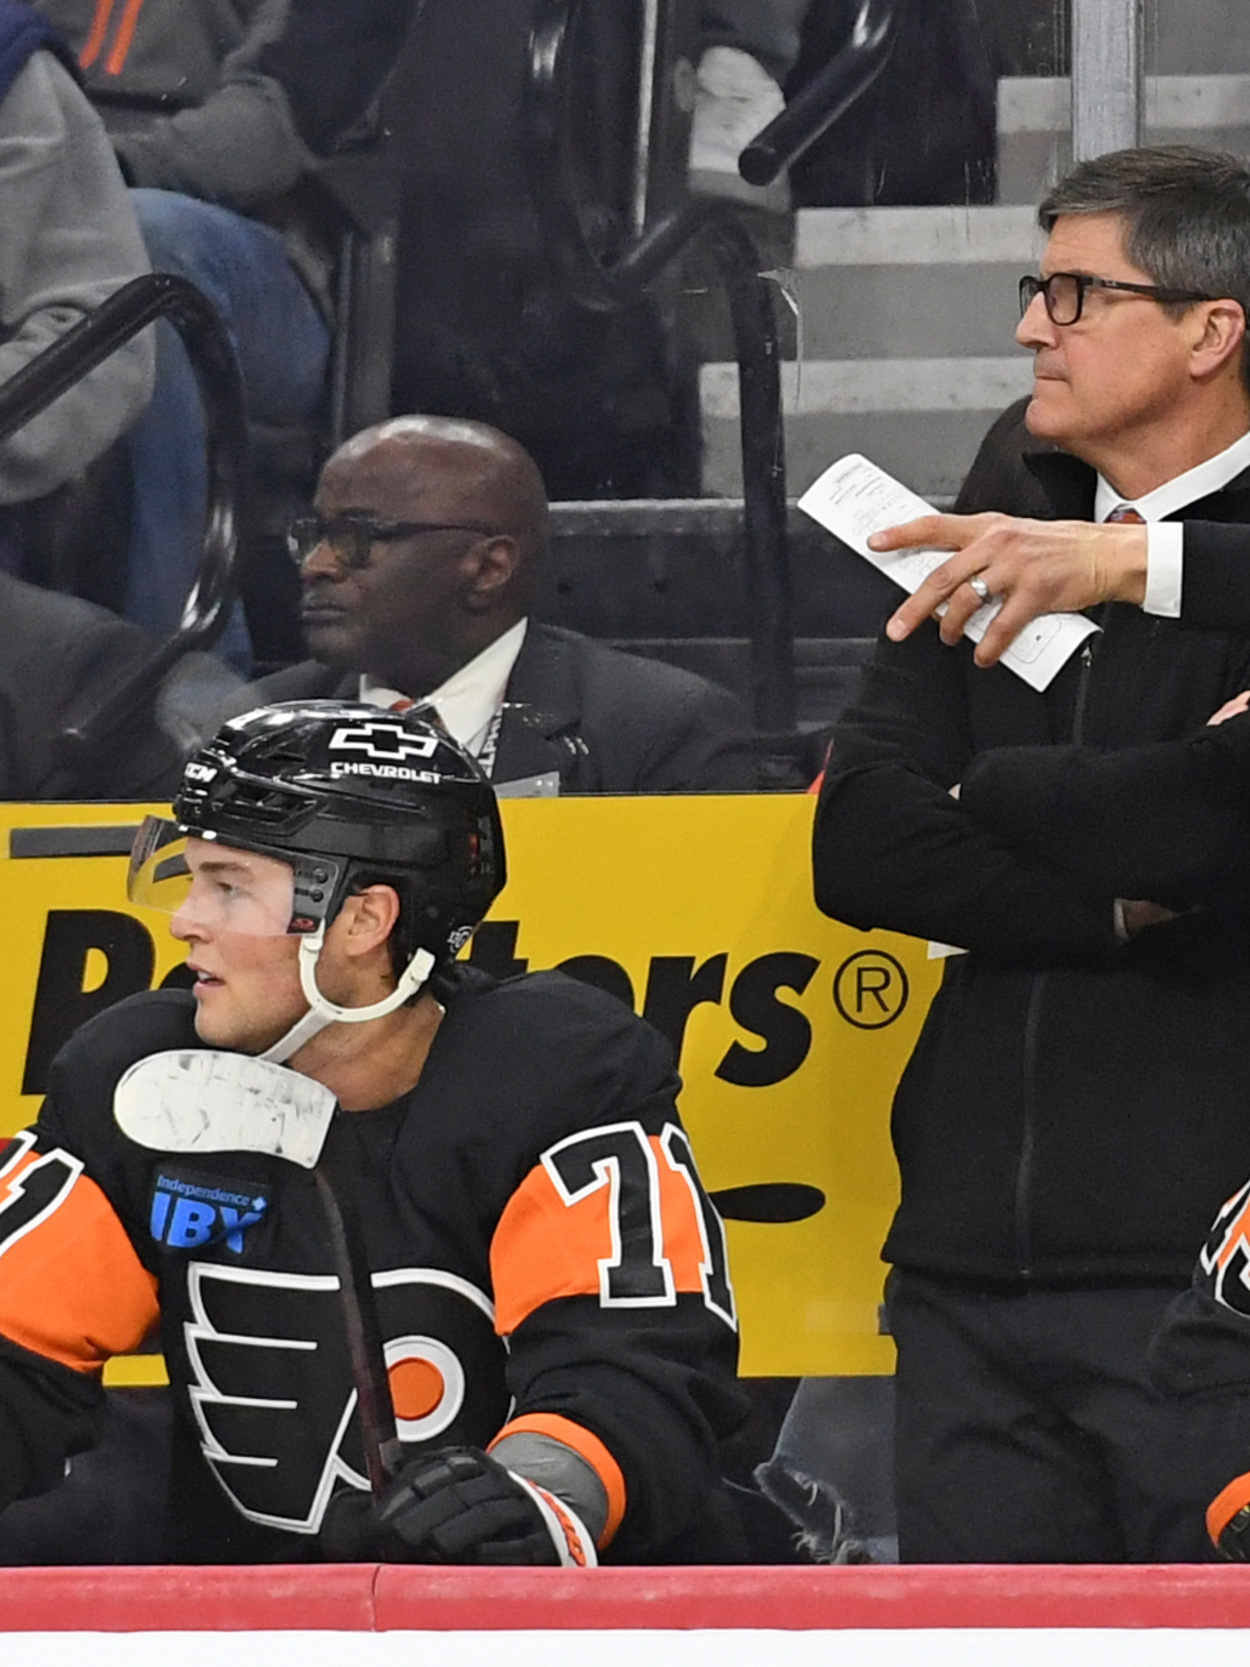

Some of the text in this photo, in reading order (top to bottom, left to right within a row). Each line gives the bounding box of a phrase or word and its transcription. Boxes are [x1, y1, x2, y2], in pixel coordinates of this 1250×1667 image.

[331, 762, 442, 784] CHEVROLET
[157, 1175, 250, 1206] Independence
[541, 1121, 738, 1333] 71
